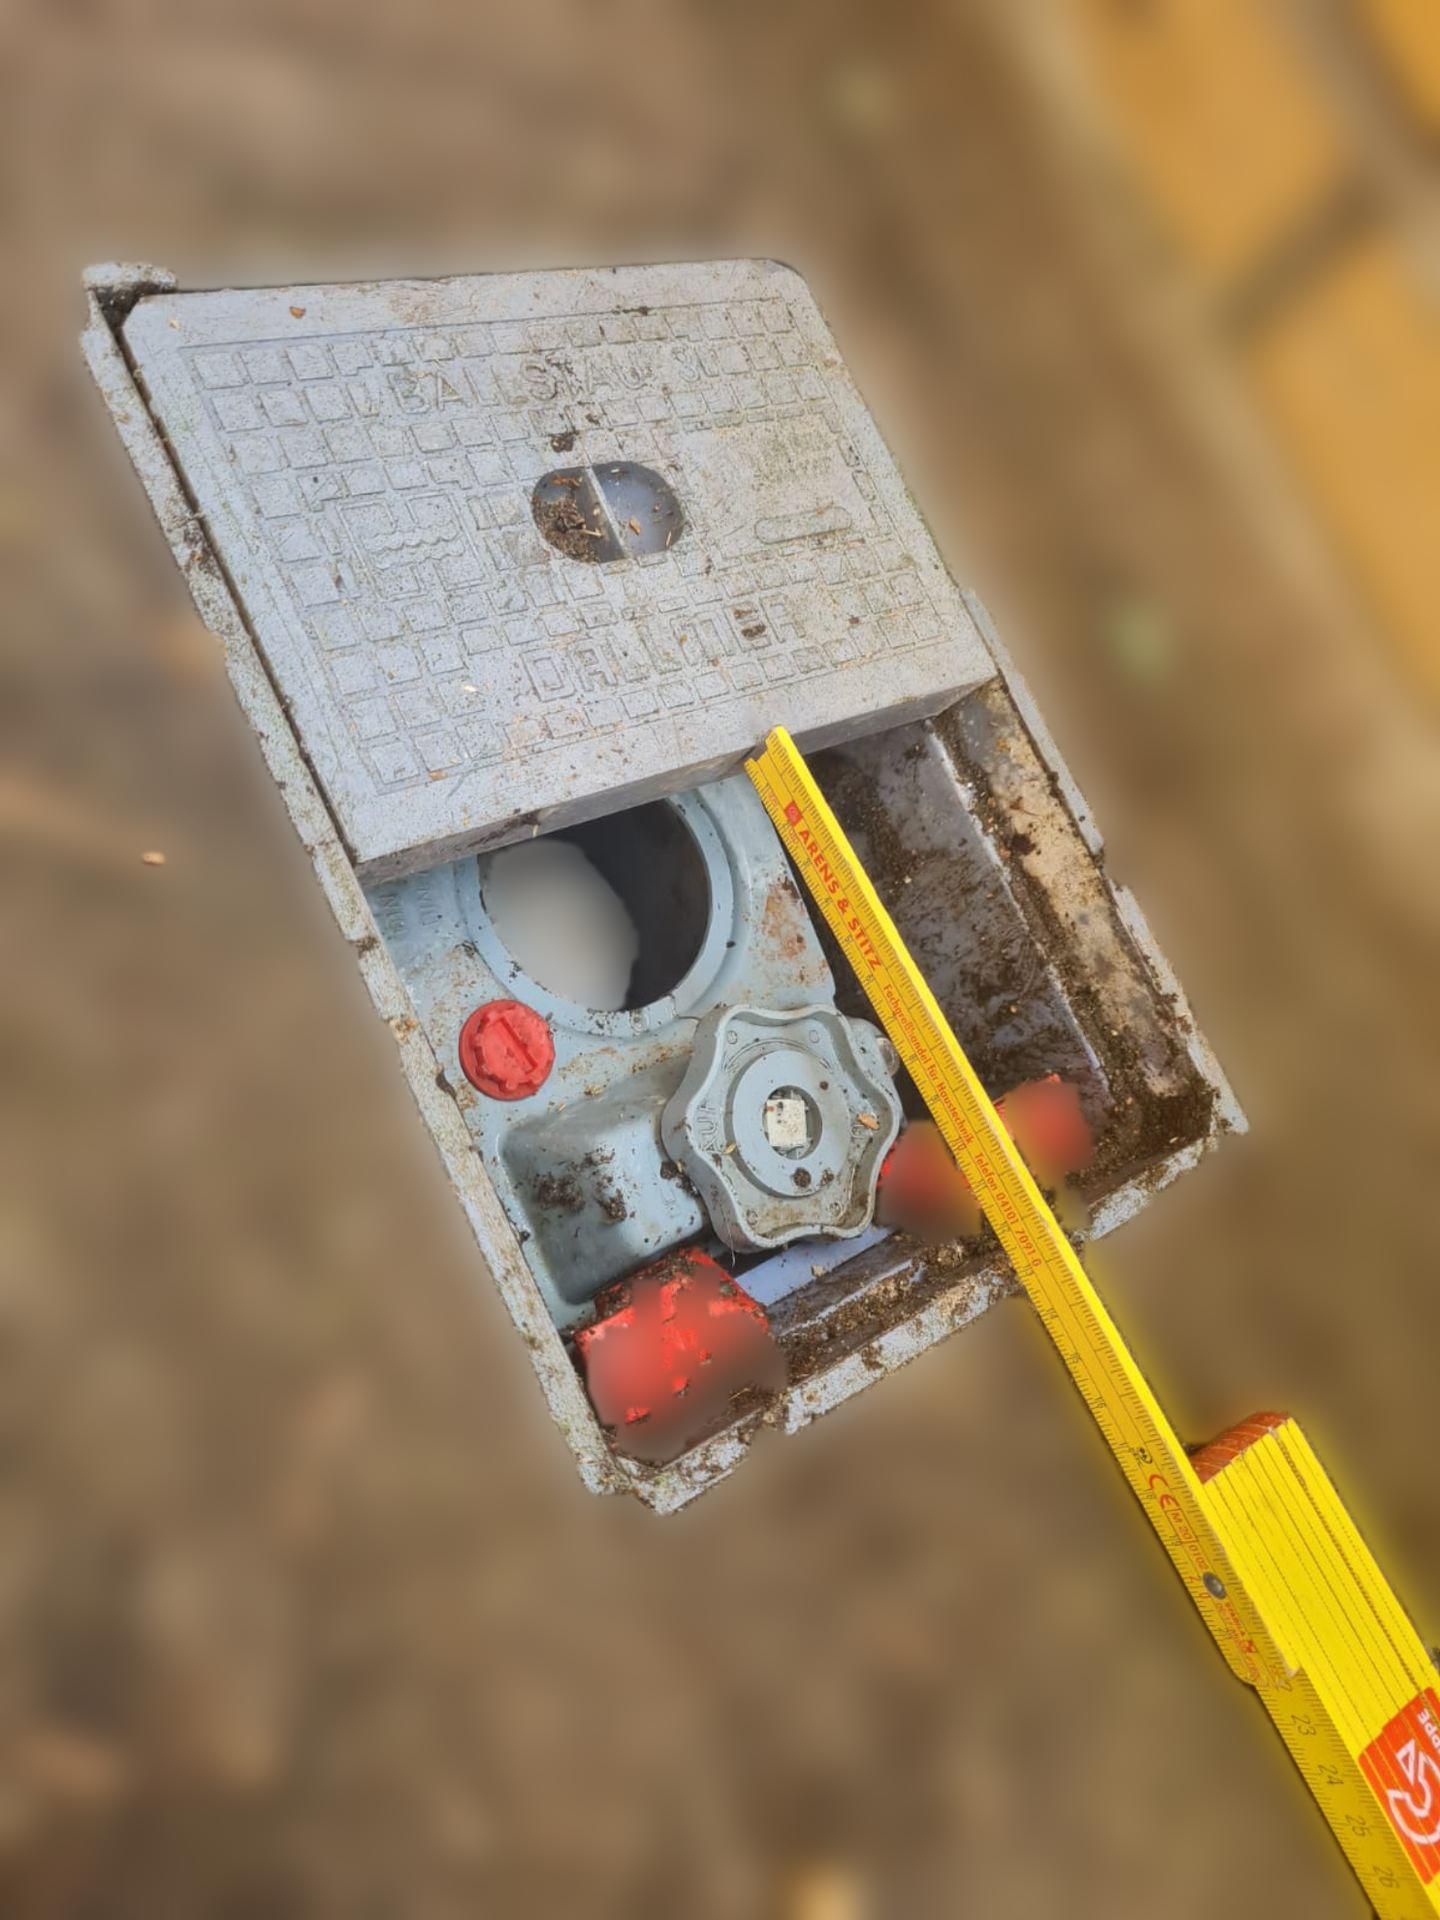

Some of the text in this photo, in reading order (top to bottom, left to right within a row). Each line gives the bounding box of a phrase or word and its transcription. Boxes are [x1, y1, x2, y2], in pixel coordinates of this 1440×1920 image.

[519, 593, 806, 703] DALLMER
[797, 828, 882, 971] ARENS & STITZ
[936, 1081, 974, 1144] Haustechnik
[973, 1151, 1002, 1191] Telefon
[1291, 1713, 1316, 1736] 23
[1318, 1764, 1343, 1786] 24
[1345, 1814, 1370, 1837] 25
[1373, 1865, 1400, 1888] 26
